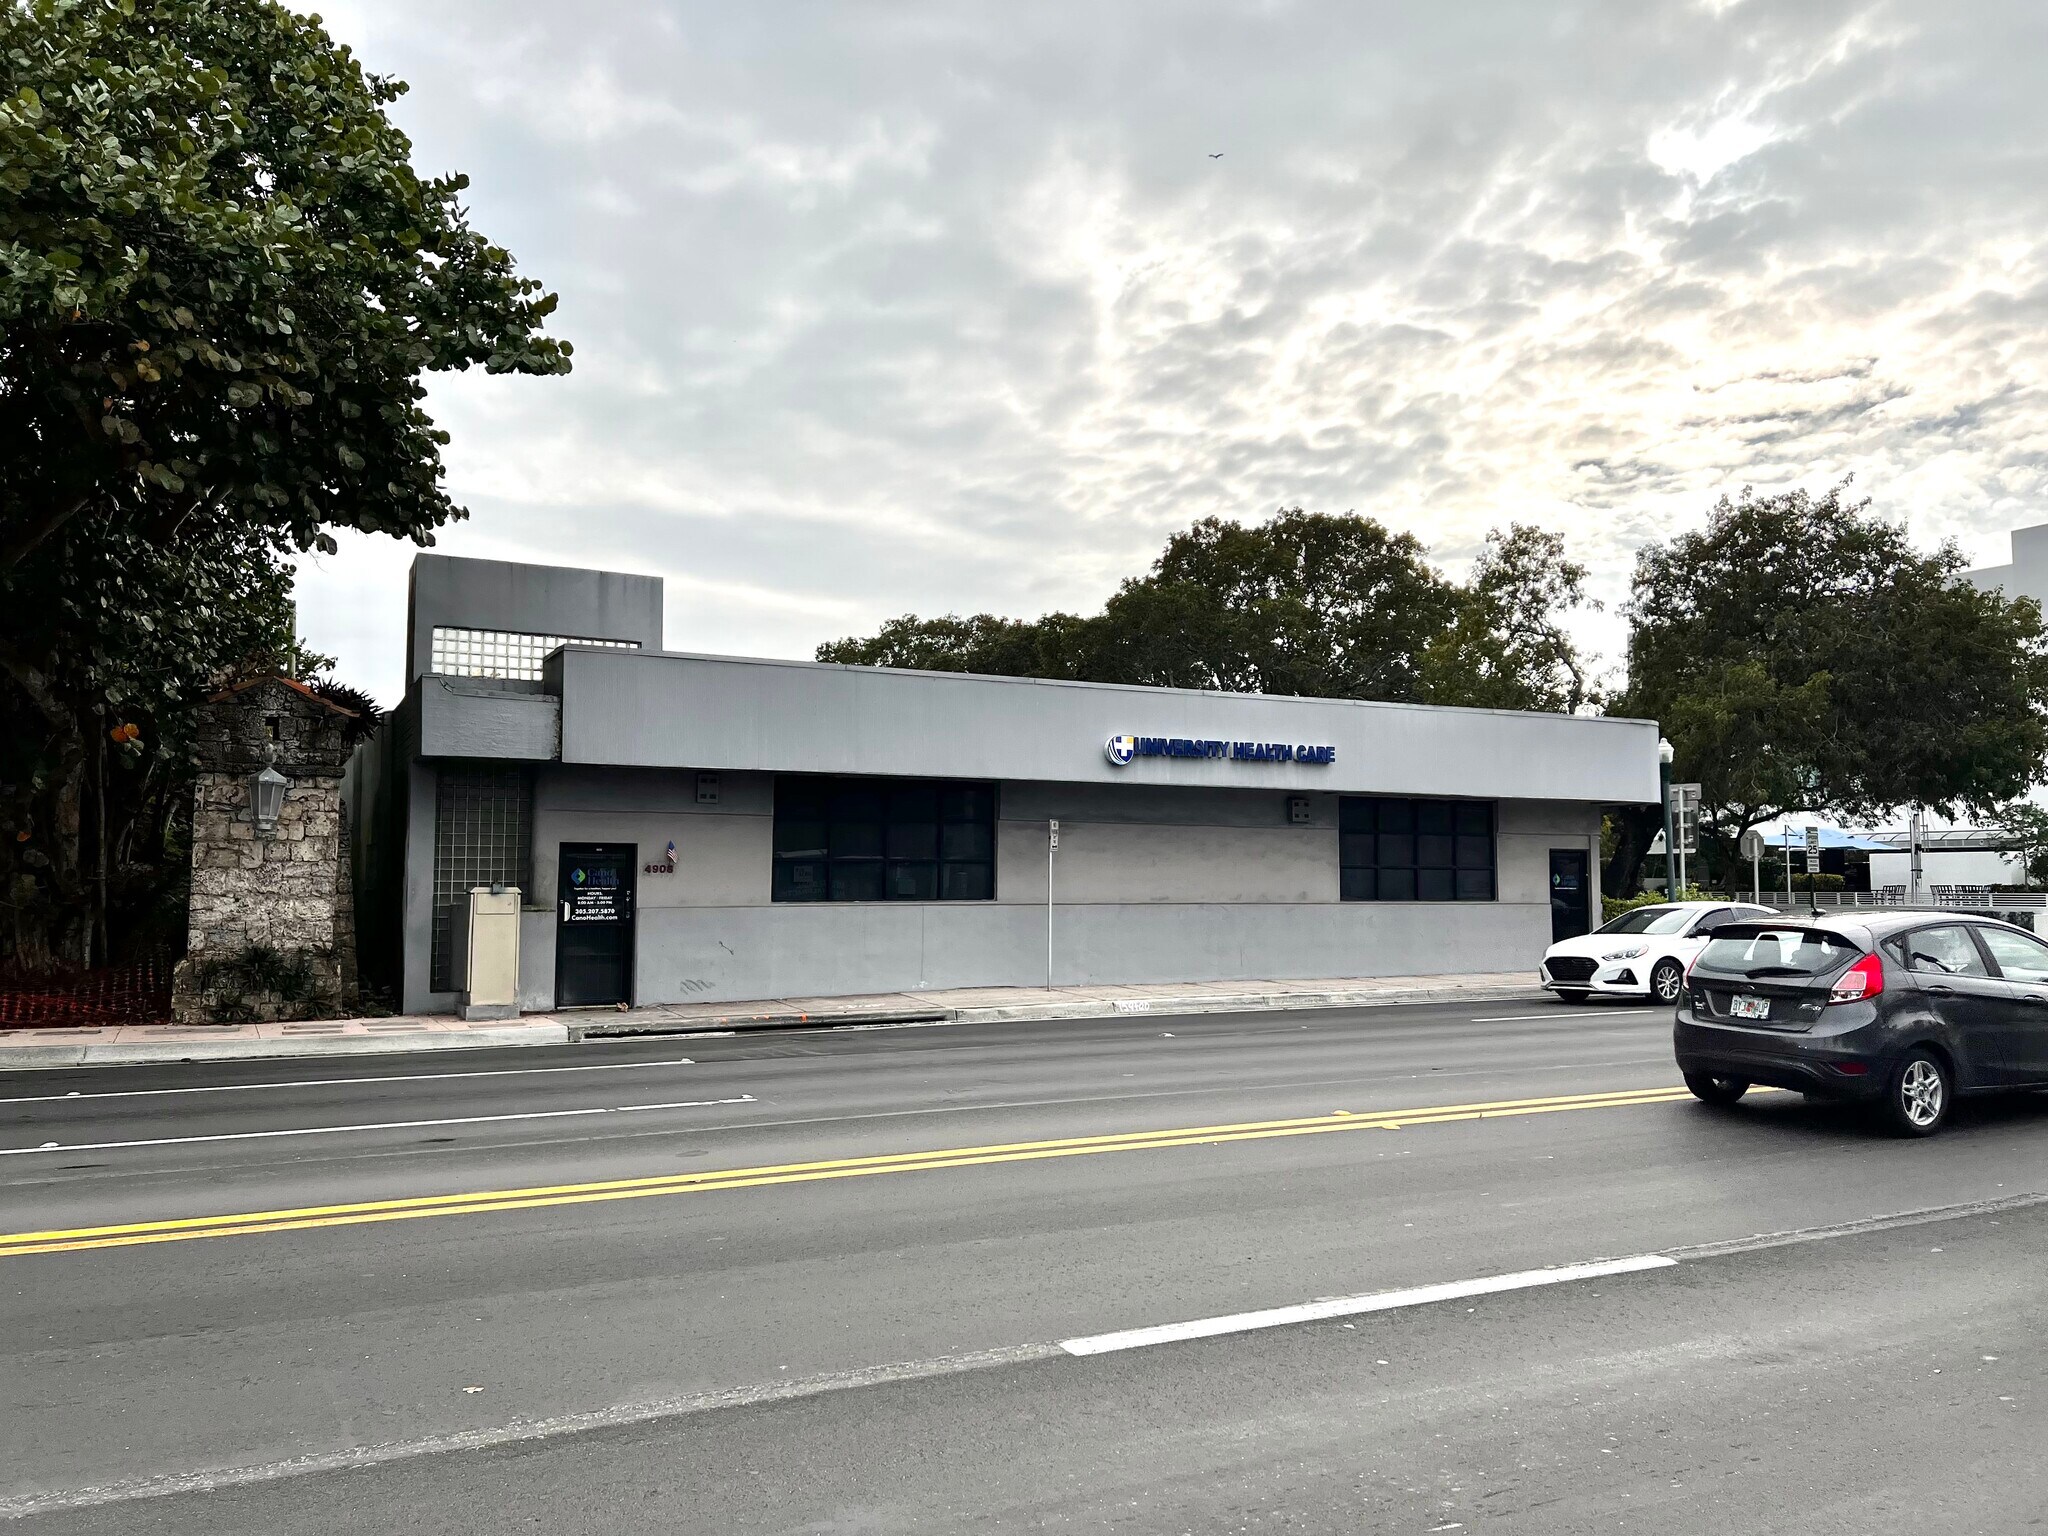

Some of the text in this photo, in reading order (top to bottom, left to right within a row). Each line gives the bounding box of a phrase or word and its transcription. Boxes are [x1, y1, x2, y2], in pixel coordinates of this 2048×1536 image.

[1133, 737, 1336, 763] UNIVERSITY HEALTH CARE
[1808, 845, 1817, 854] 25
